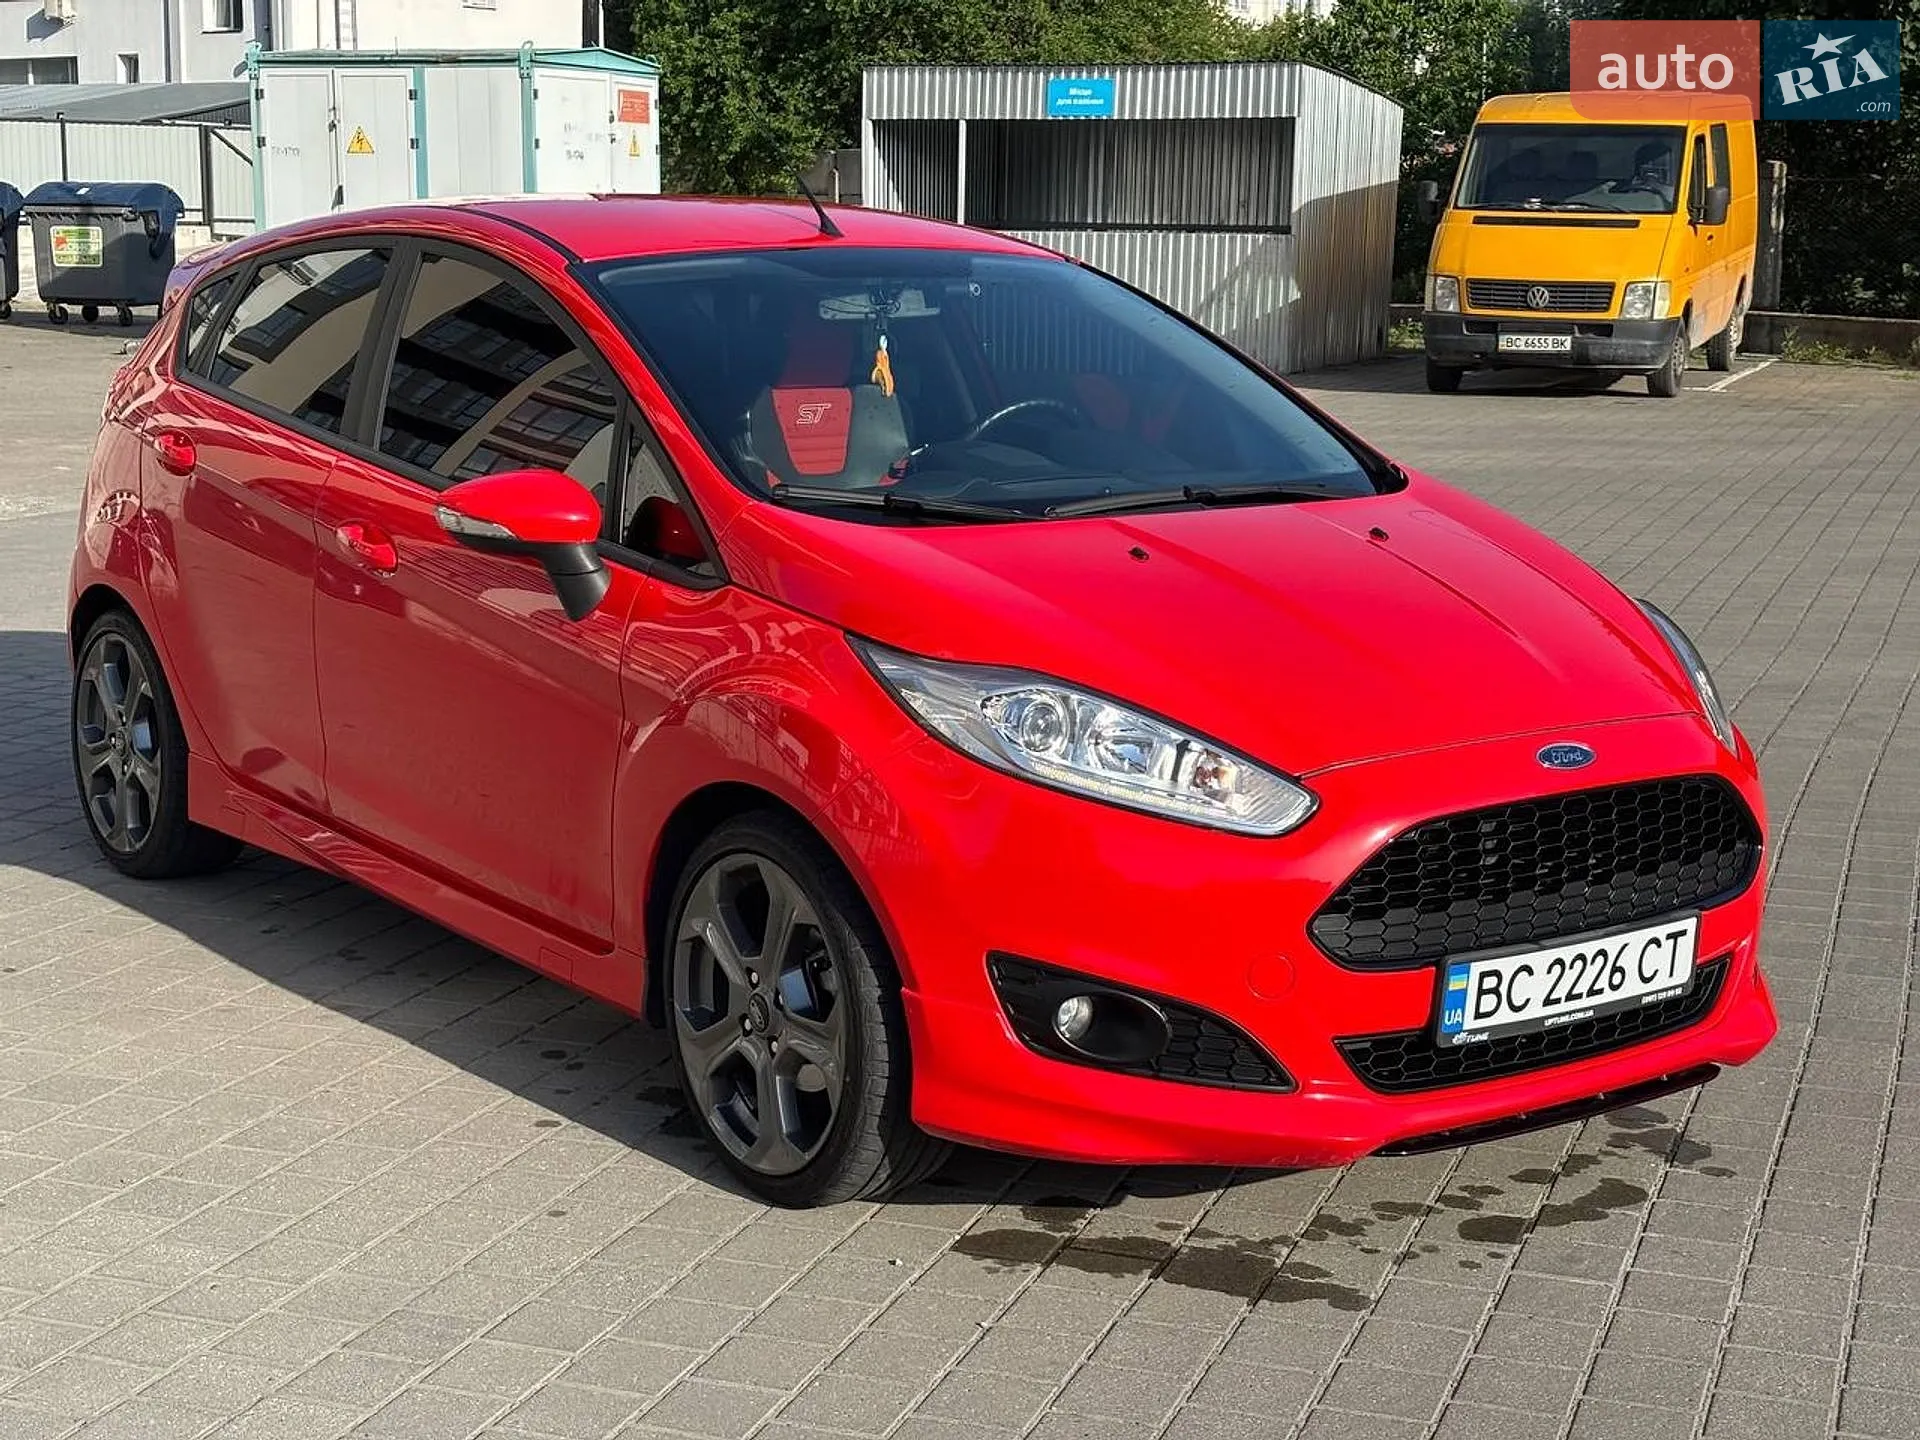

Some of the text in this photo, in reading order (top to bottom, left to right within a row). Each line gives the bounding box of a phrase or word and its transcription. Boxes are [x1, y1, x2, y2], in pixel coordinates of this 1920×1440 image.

[1506, 337, 1568, 349] BC 6655 BK
[796, 403, 832, 425] ST
[1473, 928, 1688, 1021] BC 2226 CT
[1444, 1007, 1463, 1026] UA
